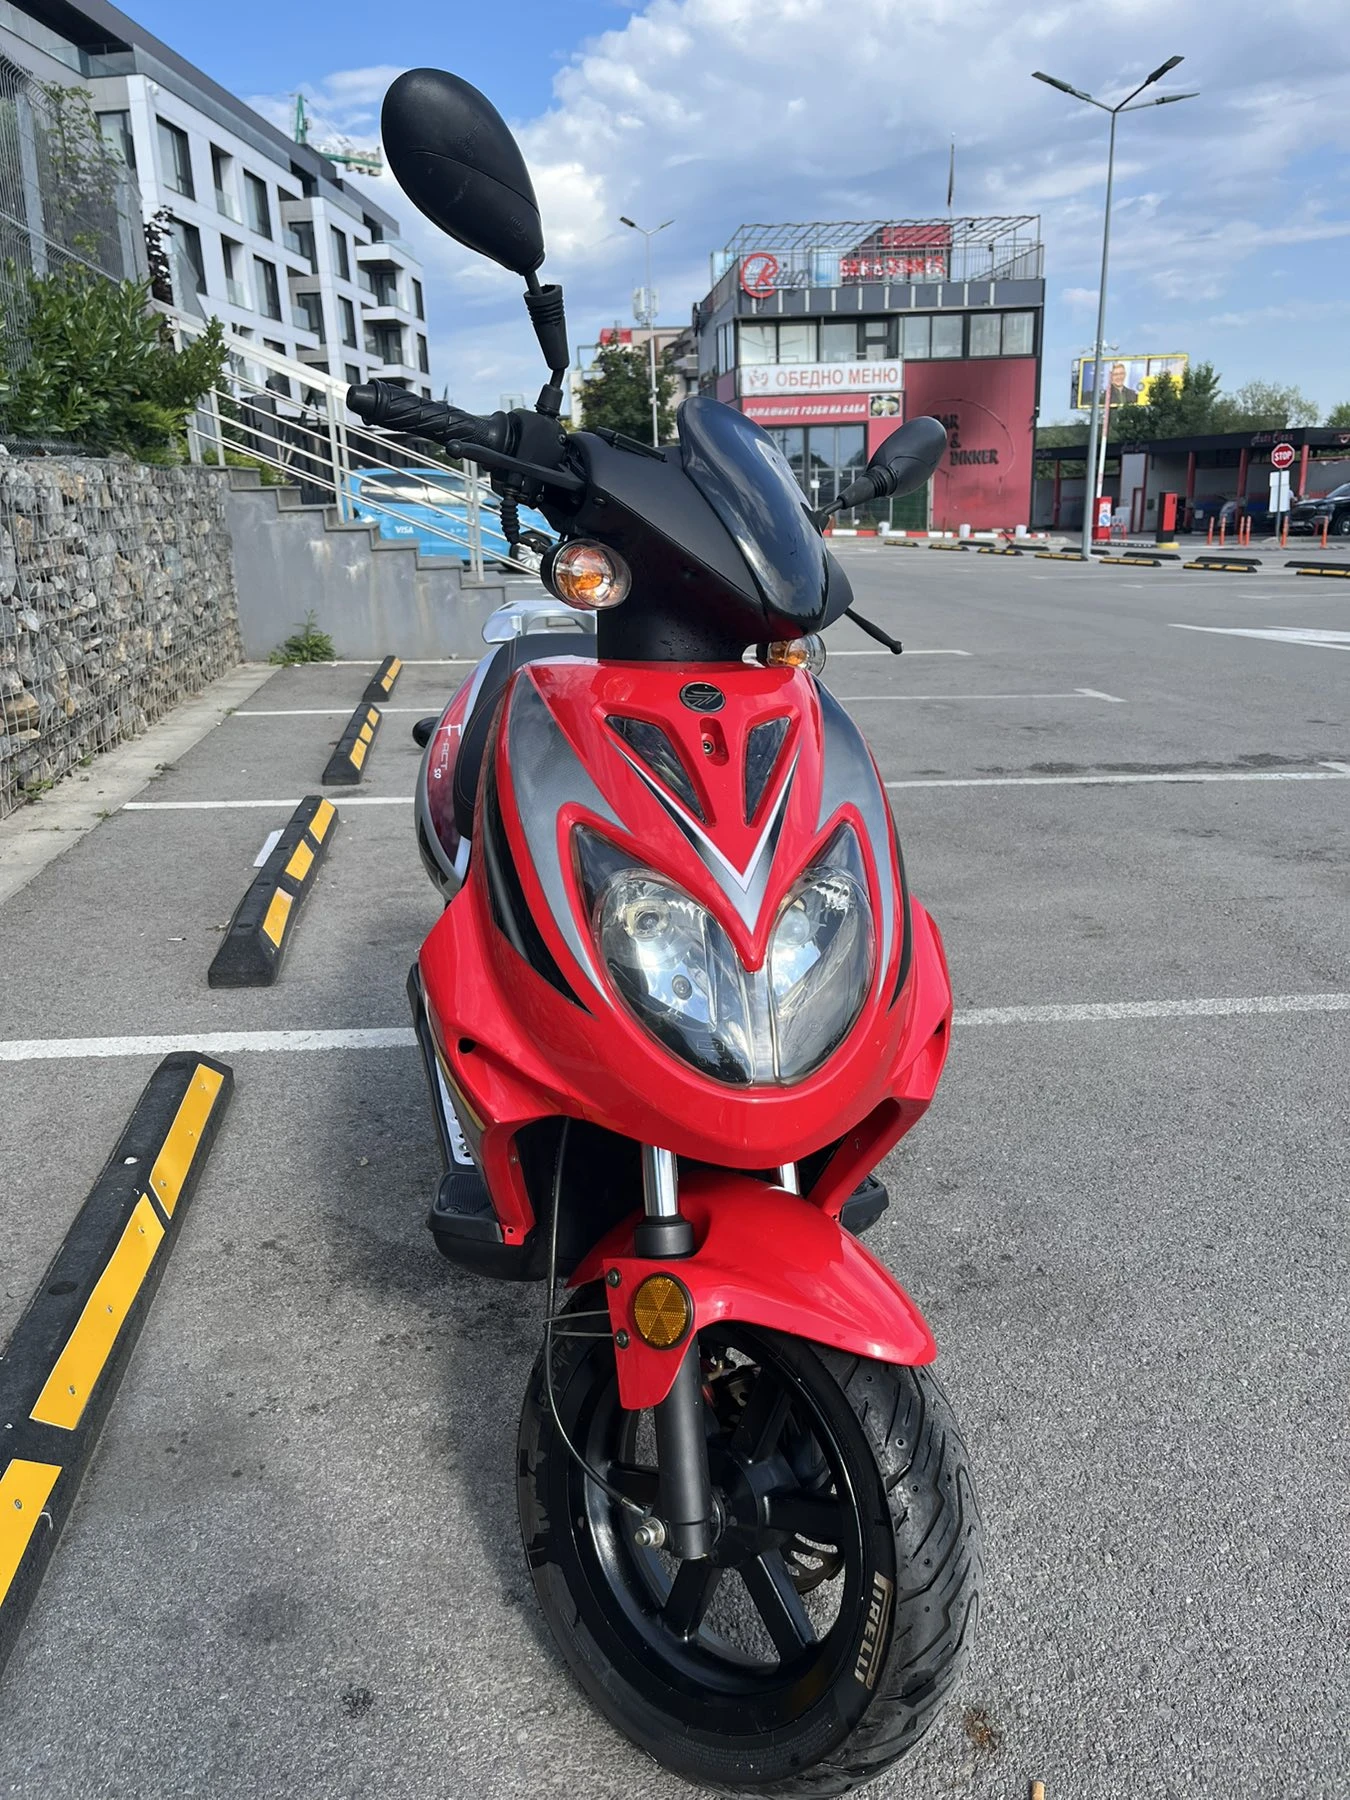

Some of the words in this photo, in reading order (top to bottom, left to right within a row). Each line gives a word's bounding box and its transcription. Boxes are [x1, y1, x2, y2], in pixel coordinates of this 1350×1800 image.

[776, 369, 844, 388] ОБЕДНО
[850, 367, 898, 385] МЕНЮ
[950, 431, 961, 448] &
[1274, 450, 1293, 462] STOP
[395, 526, 414, 534] VISA
[854, 1570, 894, 1690] PIRELLI
